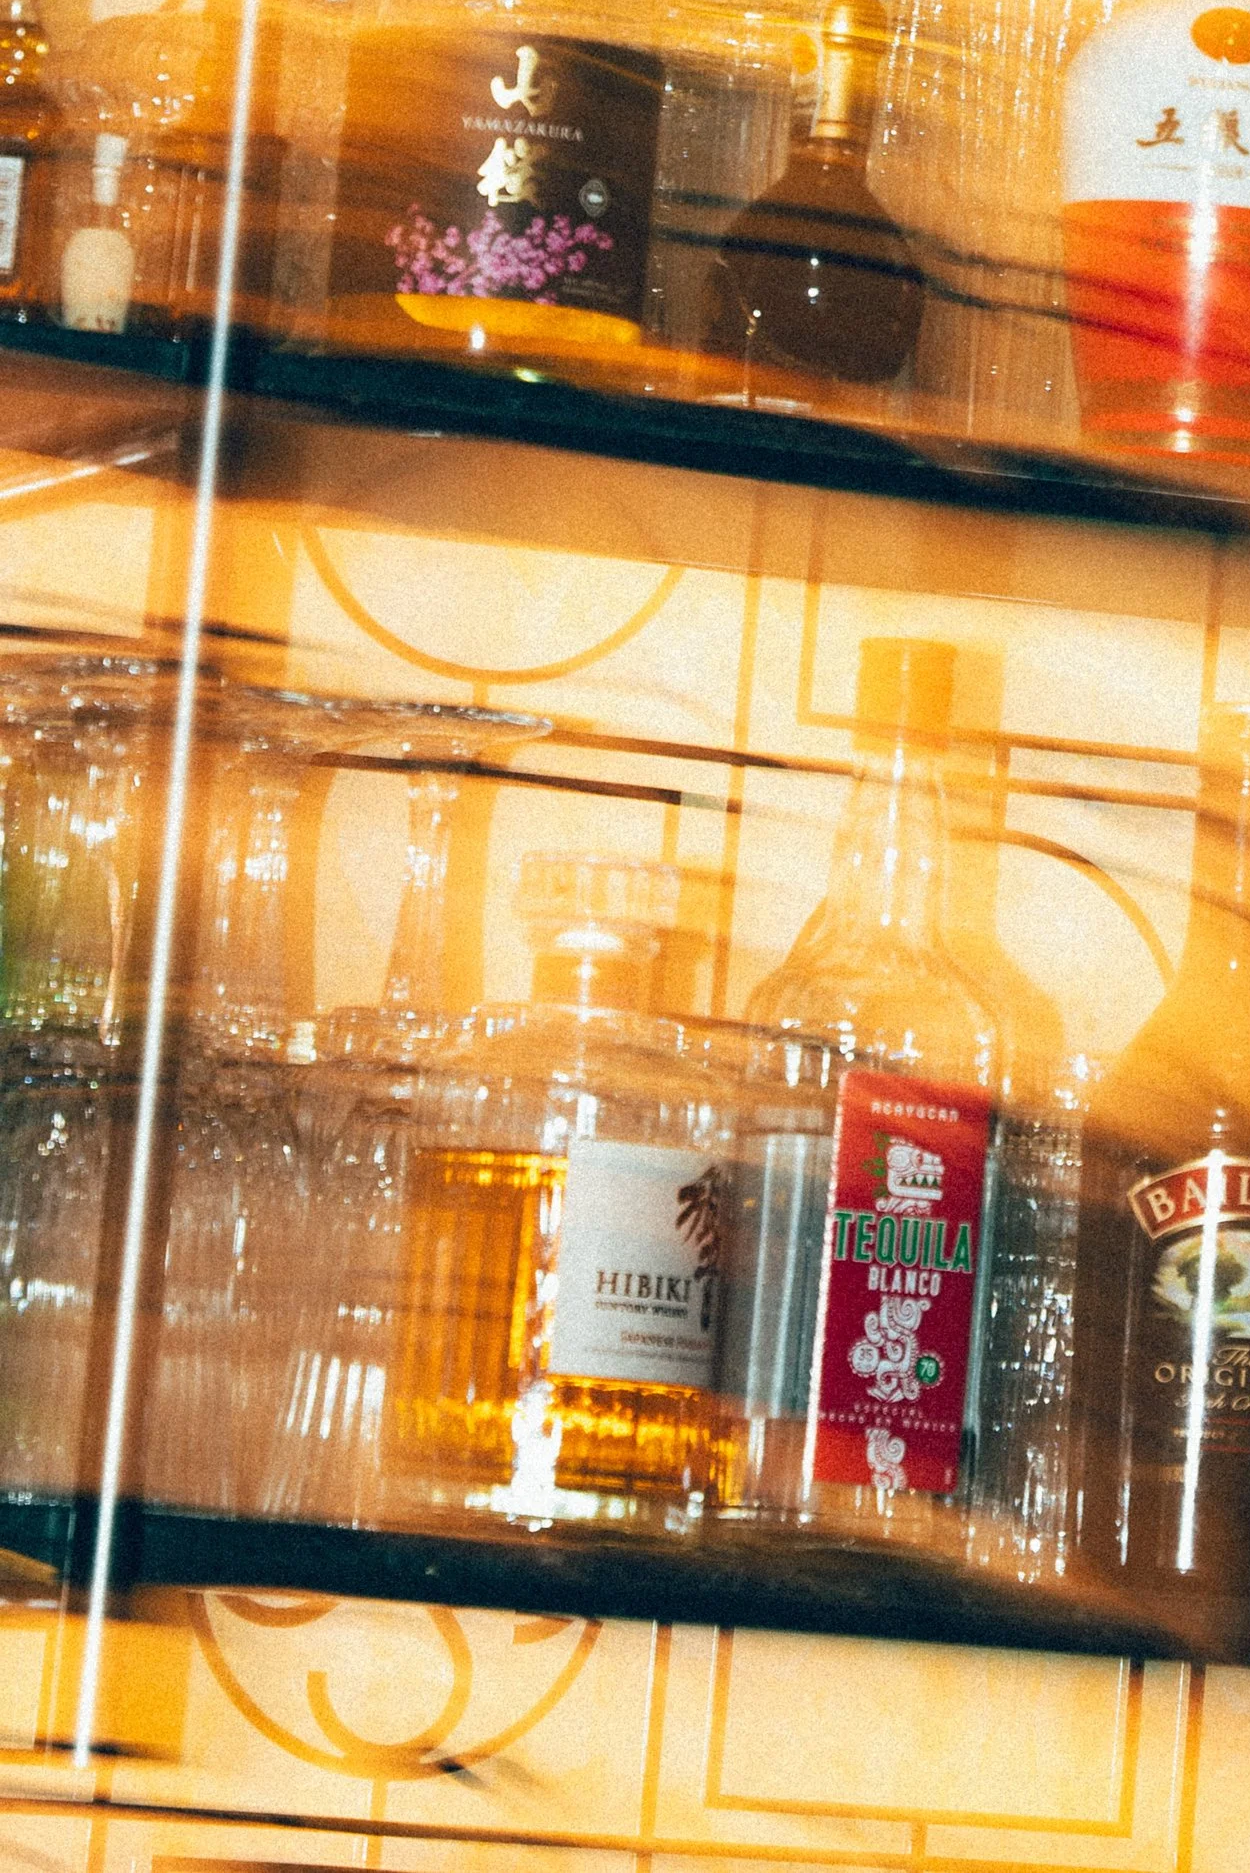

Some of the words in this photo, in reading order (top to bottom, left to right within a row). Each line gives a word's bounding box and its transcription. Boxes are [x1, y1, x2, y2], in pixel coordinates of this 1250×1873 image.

[461, 116, 584, 143] YAMAZAKURA
[834, 1209, 974, 1275] TEQUILA
[595, 1269, 692, 1303] HIBIKI
[867, 1264, 942, 1297] BLANCO
[858, 1347, 874, 1362] 35
[920, 1361, 936, 1378] 70
